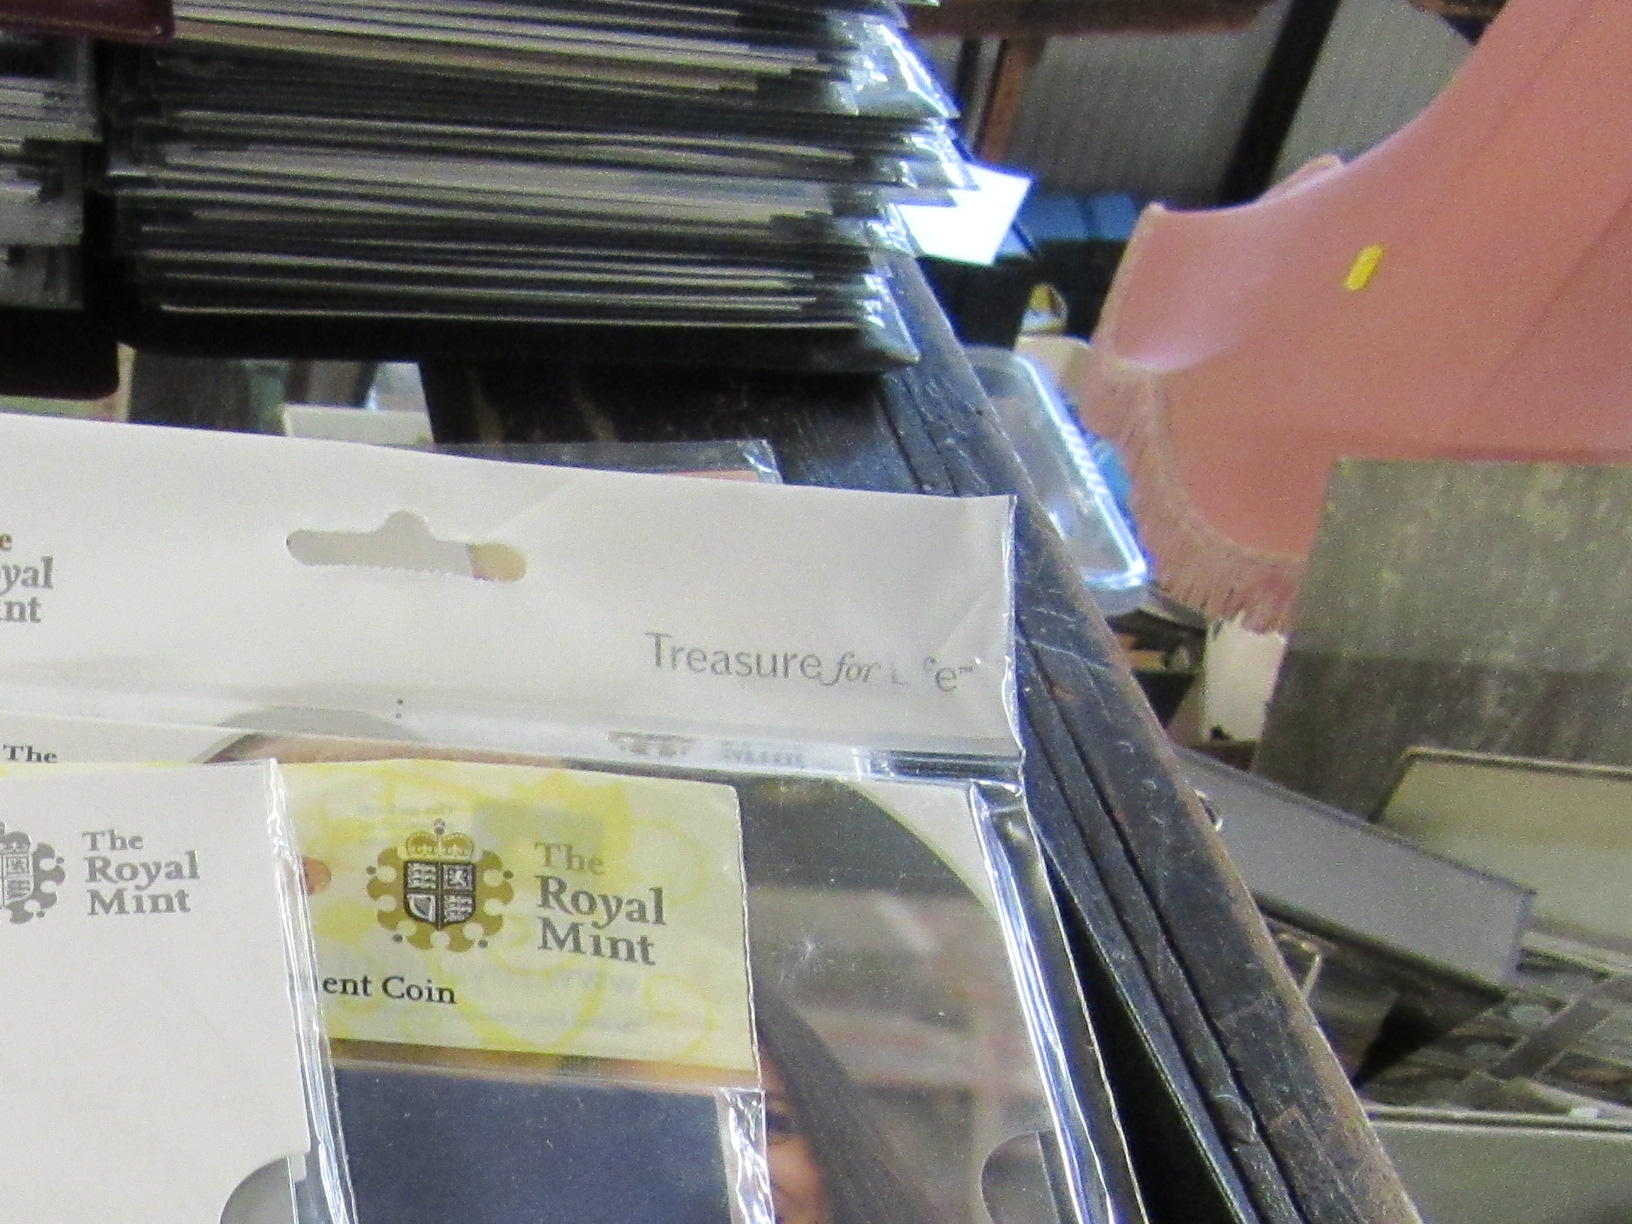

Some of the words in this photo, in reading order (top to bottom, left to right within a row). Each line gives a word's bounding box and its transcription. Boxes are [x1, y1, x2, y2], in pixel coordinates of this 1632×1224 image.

[644, 631, 824, 684] Treasure
[823, 651, 881, 686] for
[3, 744, 58, 764] The
[81, 828, 144, 851] The
[83, 850, 200, 891] Royal
[534, 840, 605, 876] The
[86, 887, 192, 916] Mint
[534, 873, 667, 930] Royal
[536, 915, 657, 966] Mint
[318, 974, 373, 998] ent
[381, 975, 458, 1006] Coin
